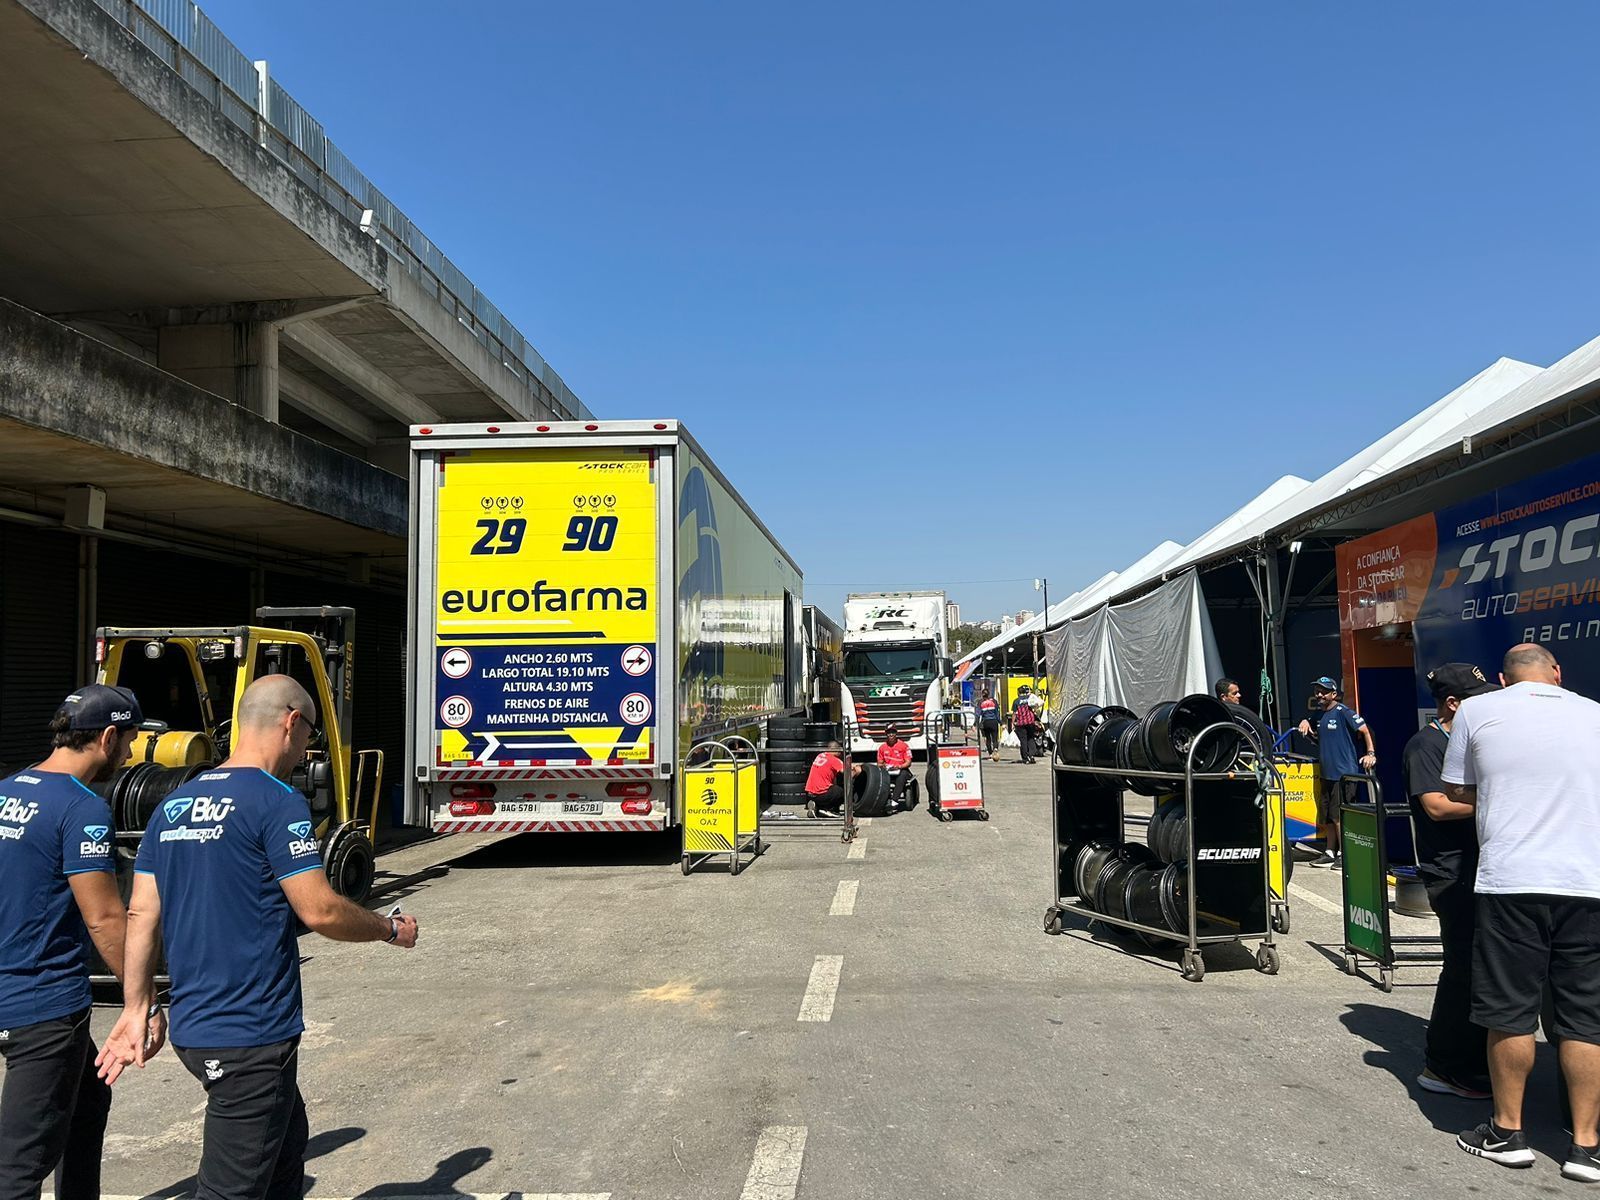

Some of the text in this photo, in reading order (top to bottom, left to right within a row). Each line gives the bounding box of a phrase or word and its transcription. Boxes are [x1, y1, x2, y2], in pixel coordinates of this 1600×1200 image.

[562, 516, 619, 552] 90
[1456, 520, 1481, 537] ACESSE
[470, 518, 527, 555] 29
[1459, 514, 1600, 584] STOC
[1362, 545, 1401, 568] CONFIANÇA
[1358, 576, 1367, 589] DA
[442, 580, 647, 613] eurofarma
[504, 653, 593, 664] ANCHO 2.60 MTS
[344, 641, 353, 701] HYSTER
[482, 667, 610, 678] LARGO TOTAL 19.10 MTS
[503, 682, 593, 692] ALTURA 4.30 MTS
[505, 698, 589, 709] FRENOS DE AIRE
[626, 701, 644, 712] 80
[448, 704, 466, 716] 80
[487, 712, 608, 724] MANTENHA DISTANCIA
[954, 782, 968, 790] 101
[1197, 848, 1262, 860] SCUDERIA
